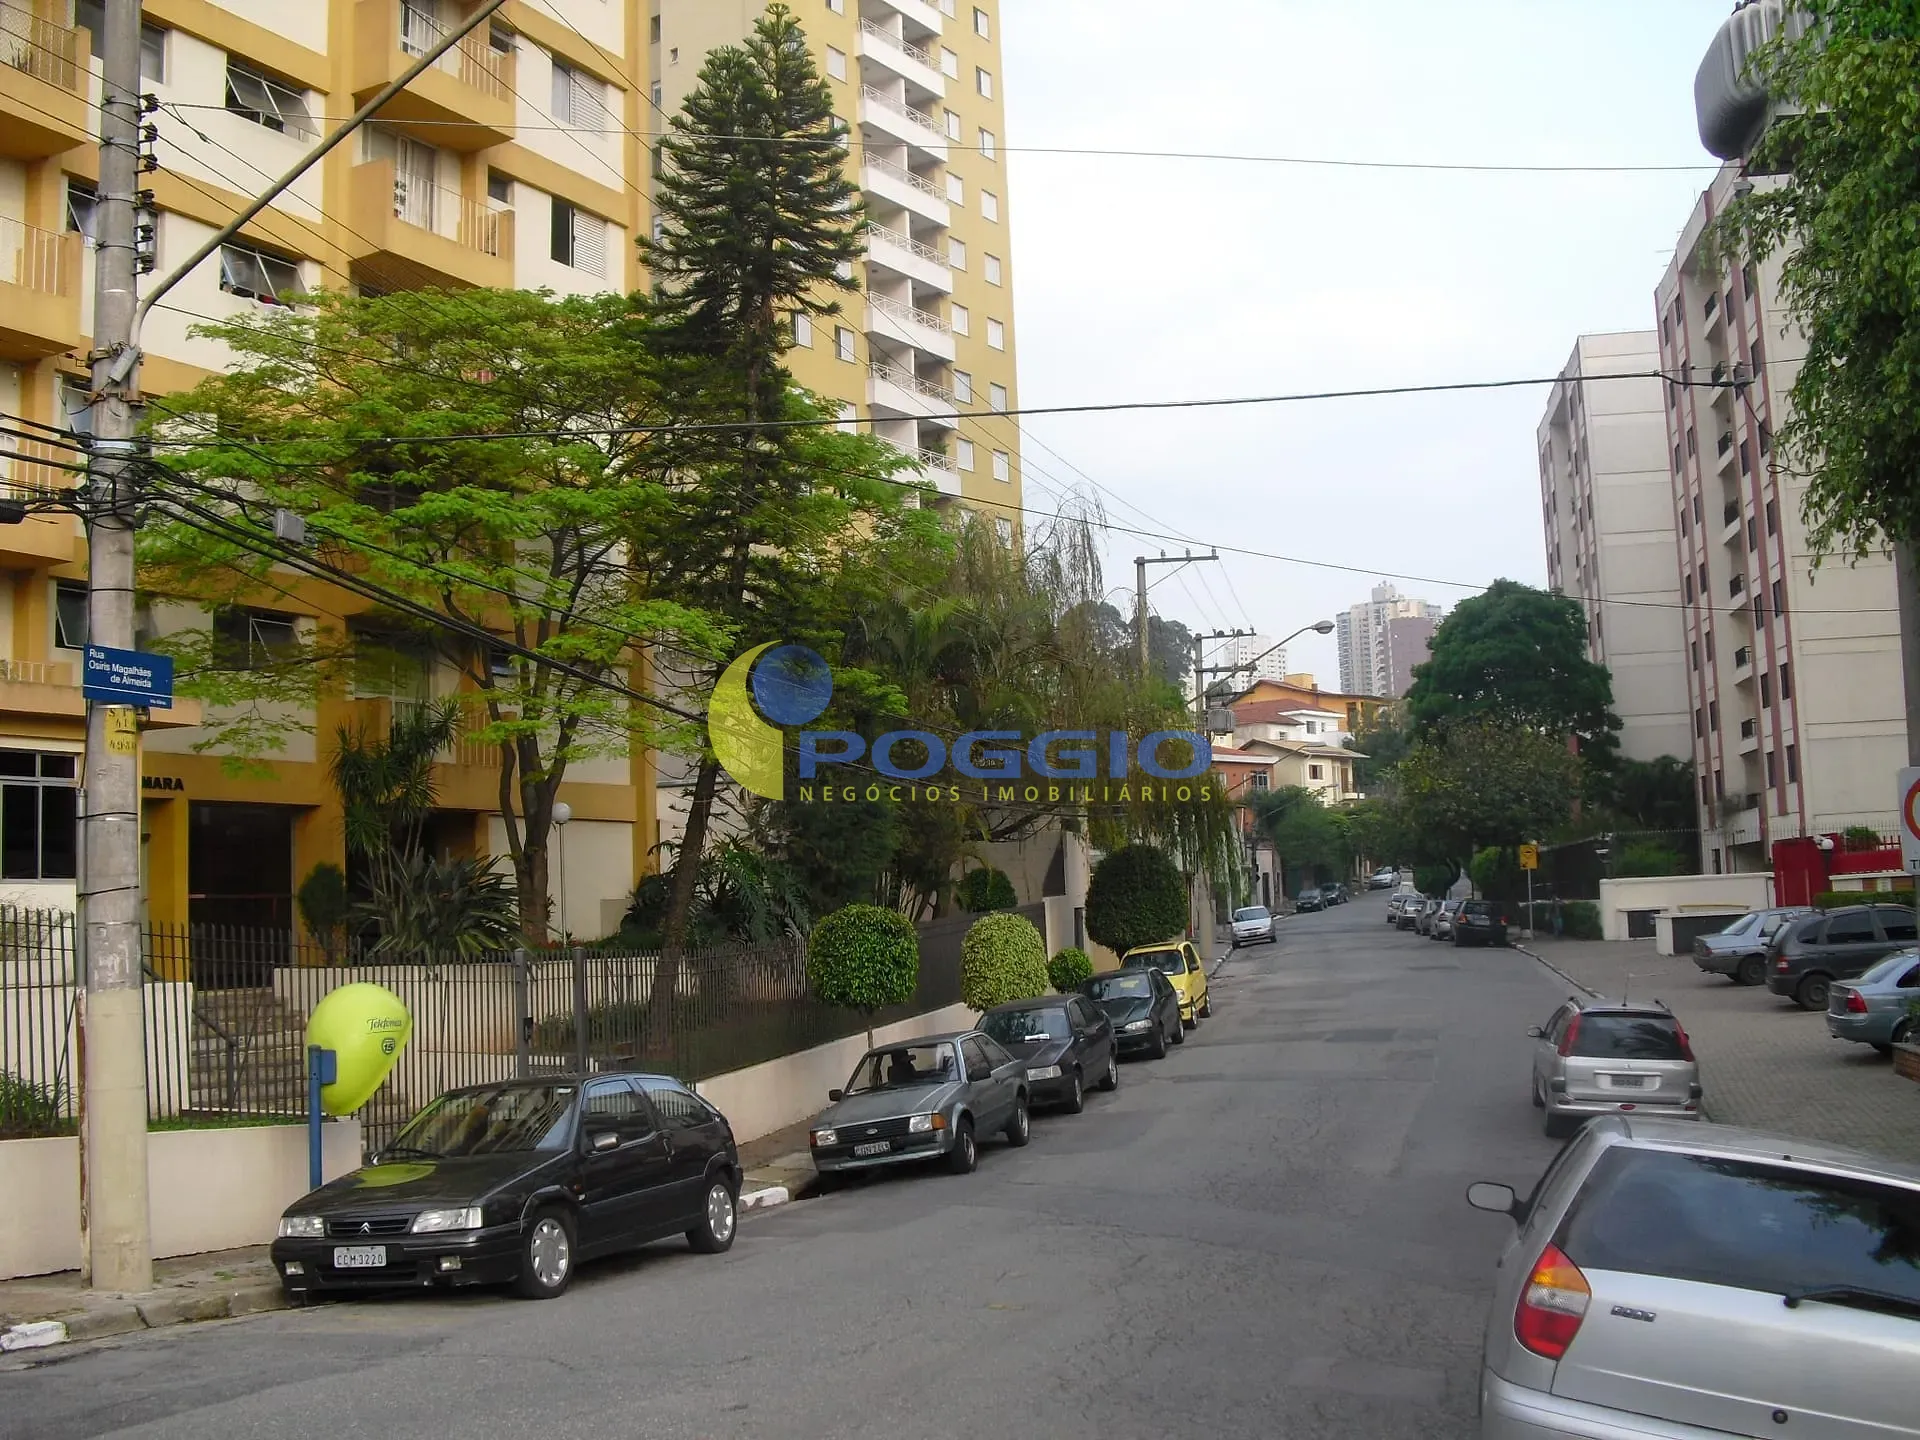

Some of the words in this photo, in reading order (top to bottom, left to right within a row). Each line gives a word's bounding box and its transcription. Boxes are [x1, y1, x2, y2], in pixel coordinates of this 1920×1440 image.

[89, 648, 105, 659] Rua
[88, 660, 111, 671] Osiris
[110, 674, 121, 683] de
[121, 676, 152, 688] Almeida
